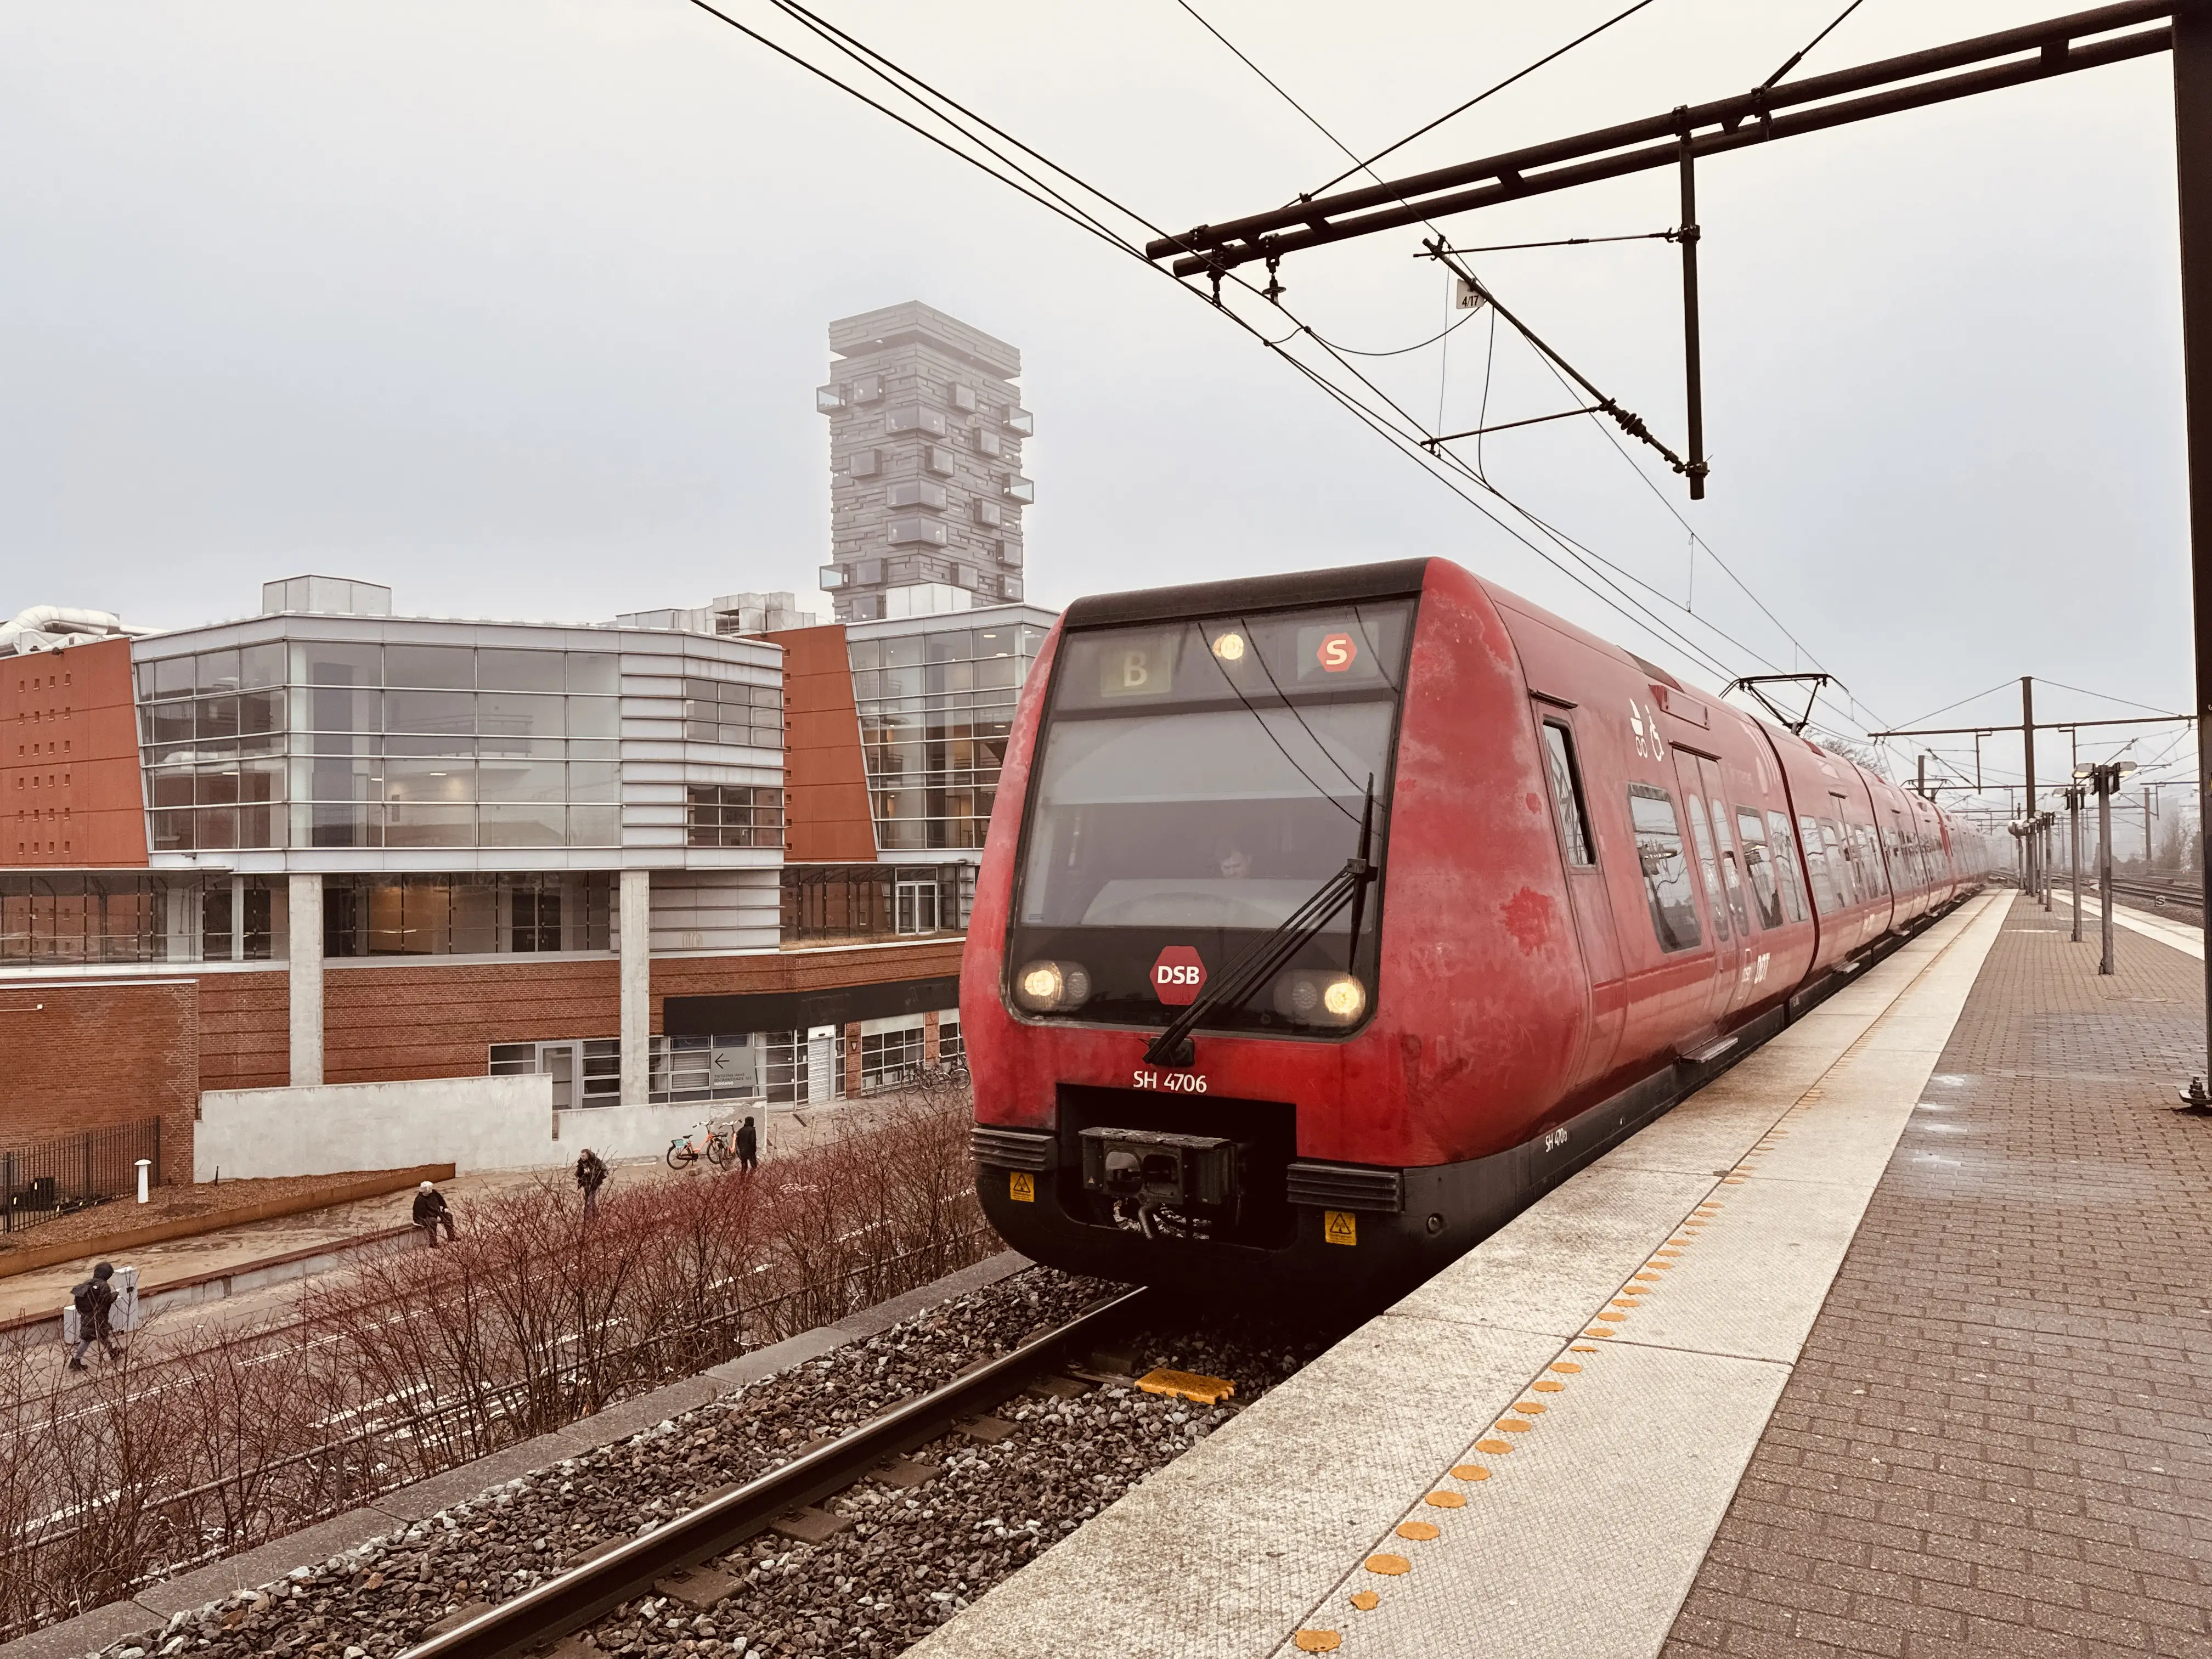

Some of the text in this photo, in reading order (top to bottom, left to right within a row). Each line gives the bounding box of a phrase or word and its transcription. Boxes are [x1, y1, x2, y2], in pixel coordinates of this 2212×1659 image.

[1462, 295, 1479, 307] 4/17
[1326, 639, 1347, 665] S
[1124, 651, 1147, 687] B
[2155, 897, 2165, 905] S
[1157, 966, 1200, 984] DSB
[1133, 1070, 1207, 1093] SH 4706
[1545, 1133, 1554, 1153] SH
